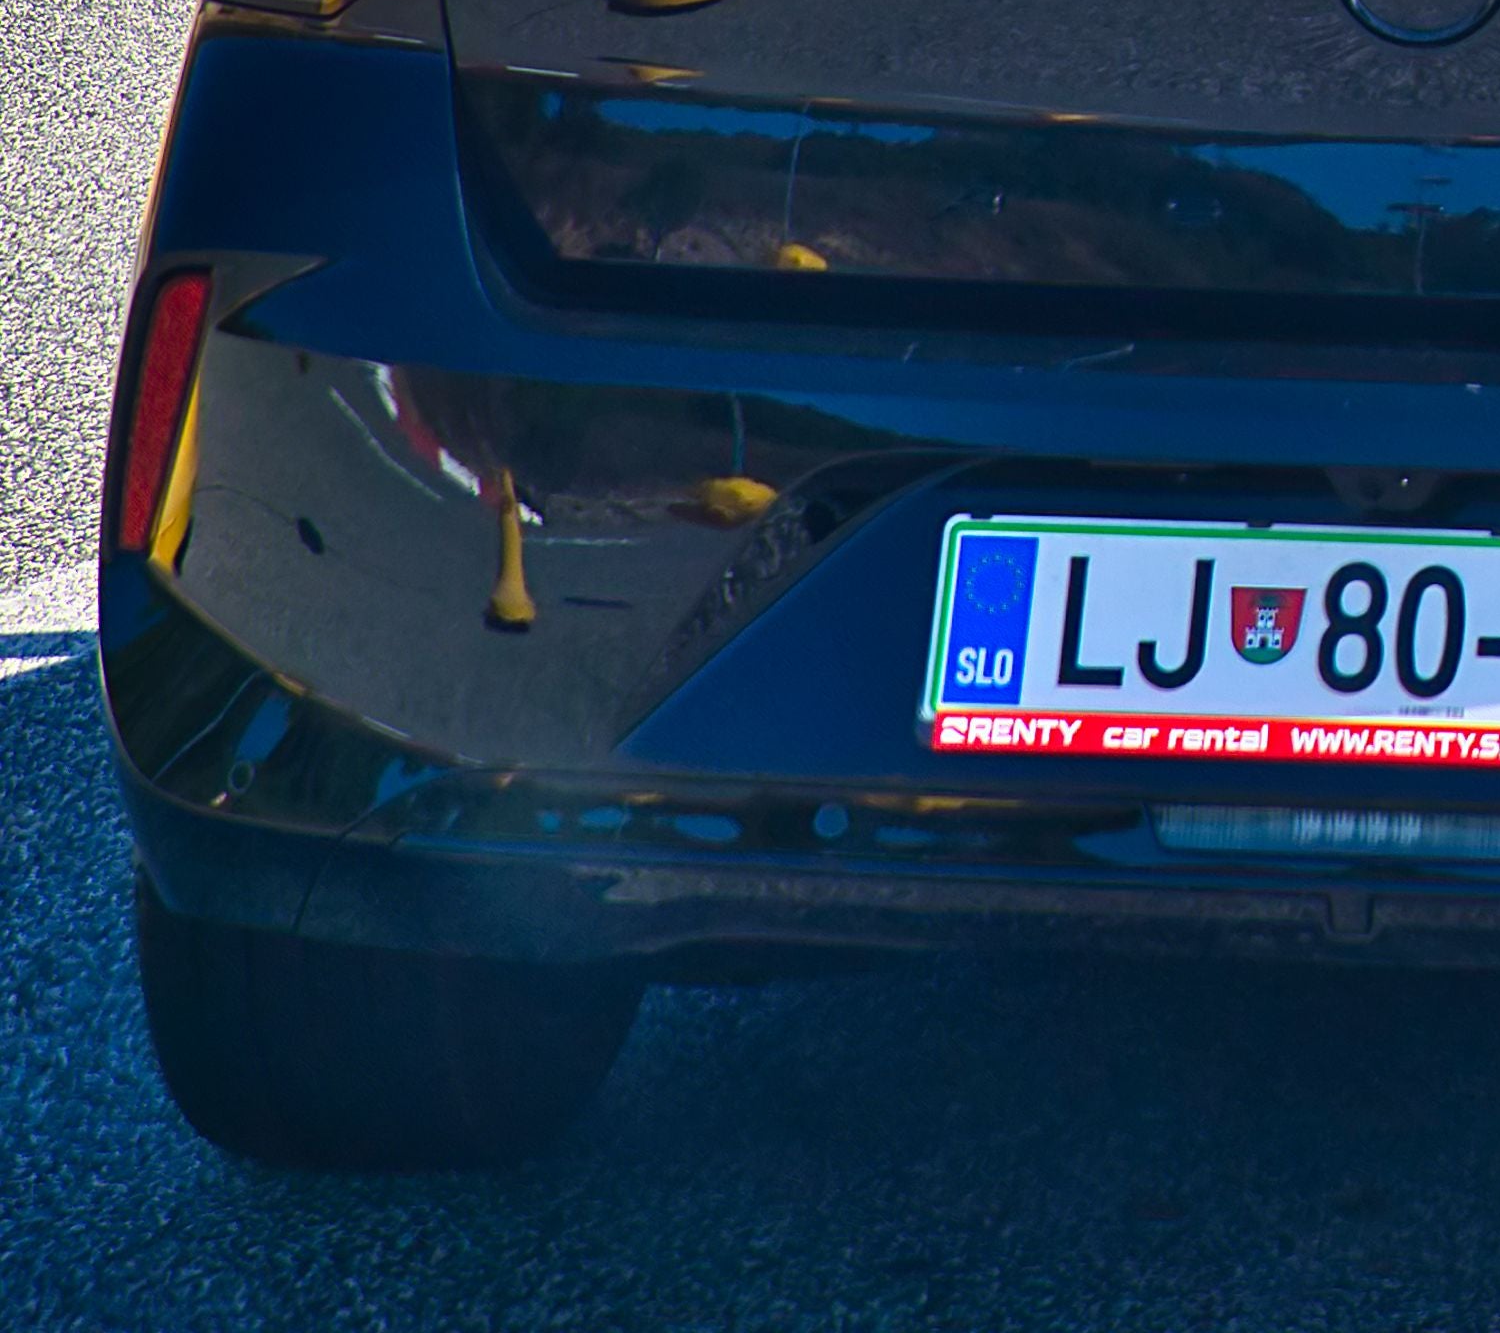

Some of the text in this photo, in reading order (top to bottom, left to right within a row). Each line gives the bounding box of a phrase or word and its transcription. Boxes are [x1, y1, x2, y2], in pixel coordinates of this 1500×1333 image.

[1057, 555, 1217, 690] LJ
[956, 647, 1014, 685] SLO
[967, 717, 1083, 747] RENTY
[1102, 726, 1160, 749] car
[1167, 723, 1269, 752] rental
